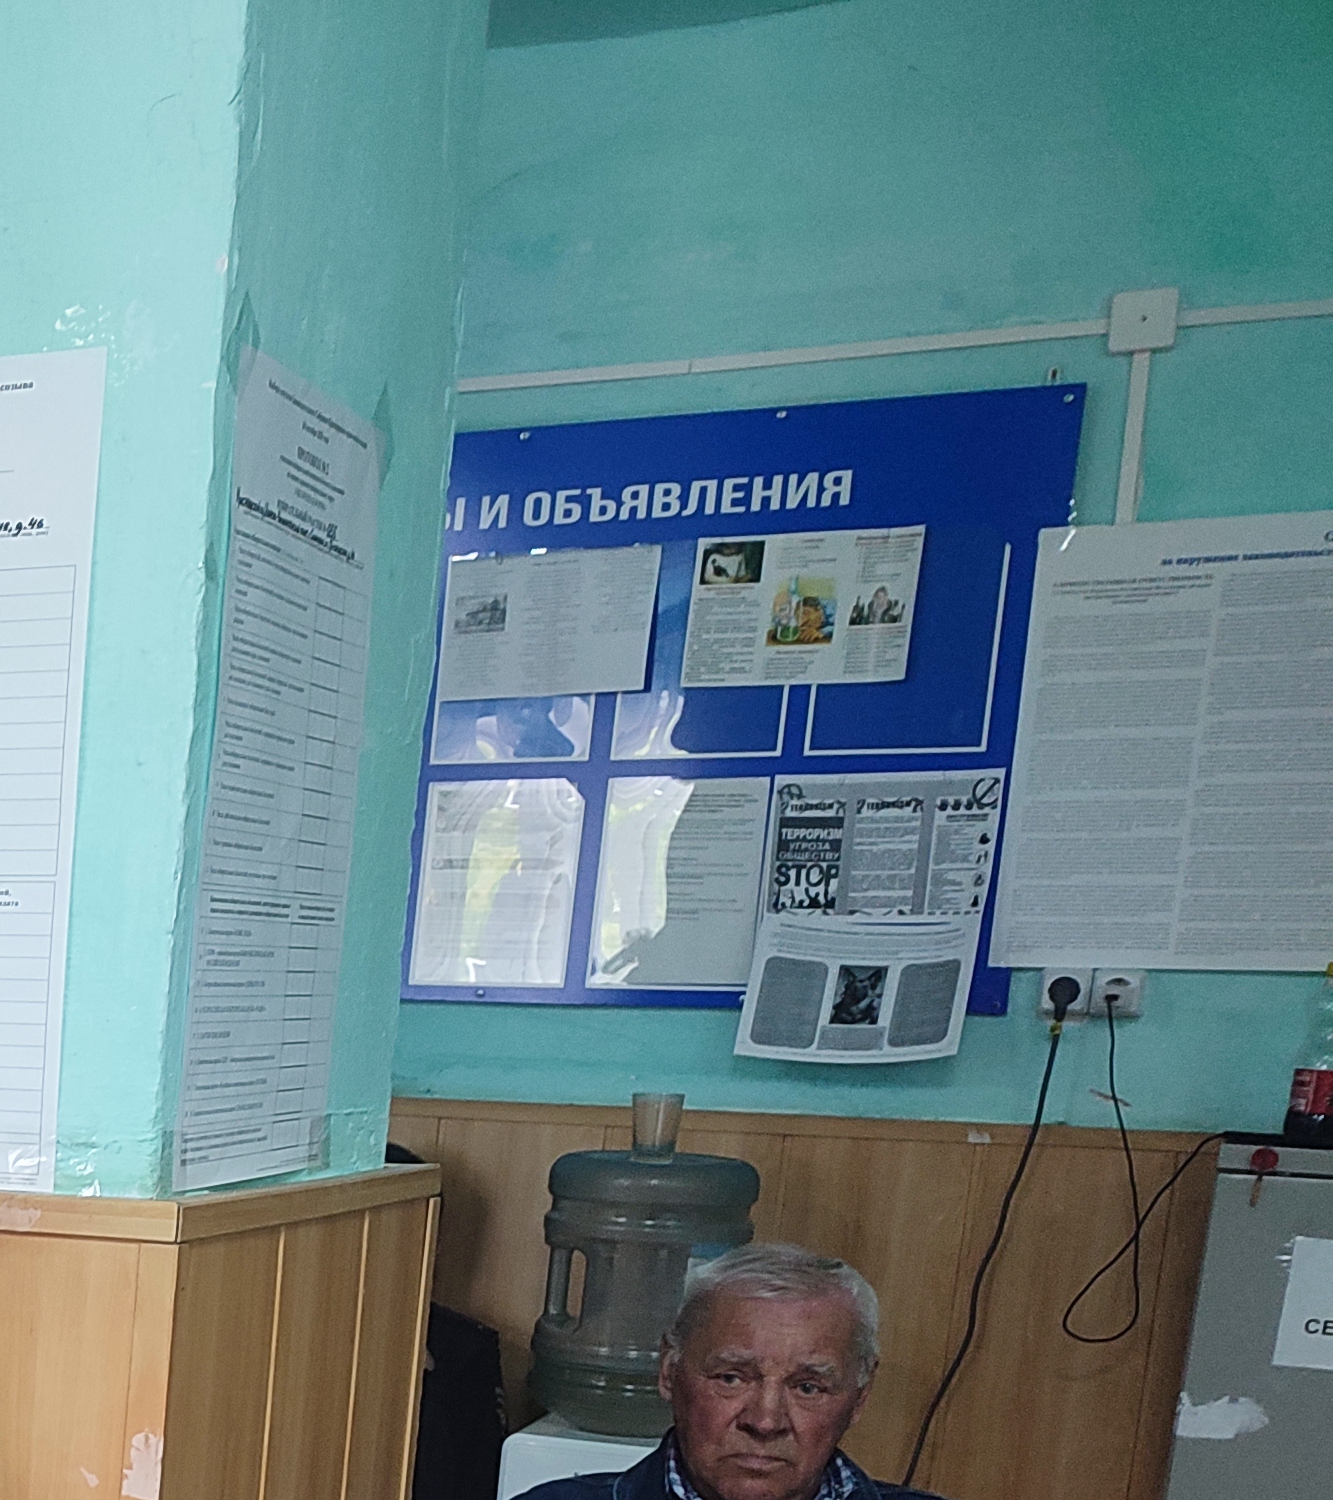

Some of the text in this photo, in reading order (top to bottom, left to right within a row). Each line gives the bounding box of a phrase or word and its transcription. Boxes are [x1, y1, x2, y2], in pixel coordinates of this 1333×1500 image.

[479, 494, 510, 529] И
[523, 469, 853, 527] ОБЪЯВЛЕНИЯ
[781, 828, 843, 840] ТЕРРОРИЗМ
[774, 864, 840, 887] STOP
